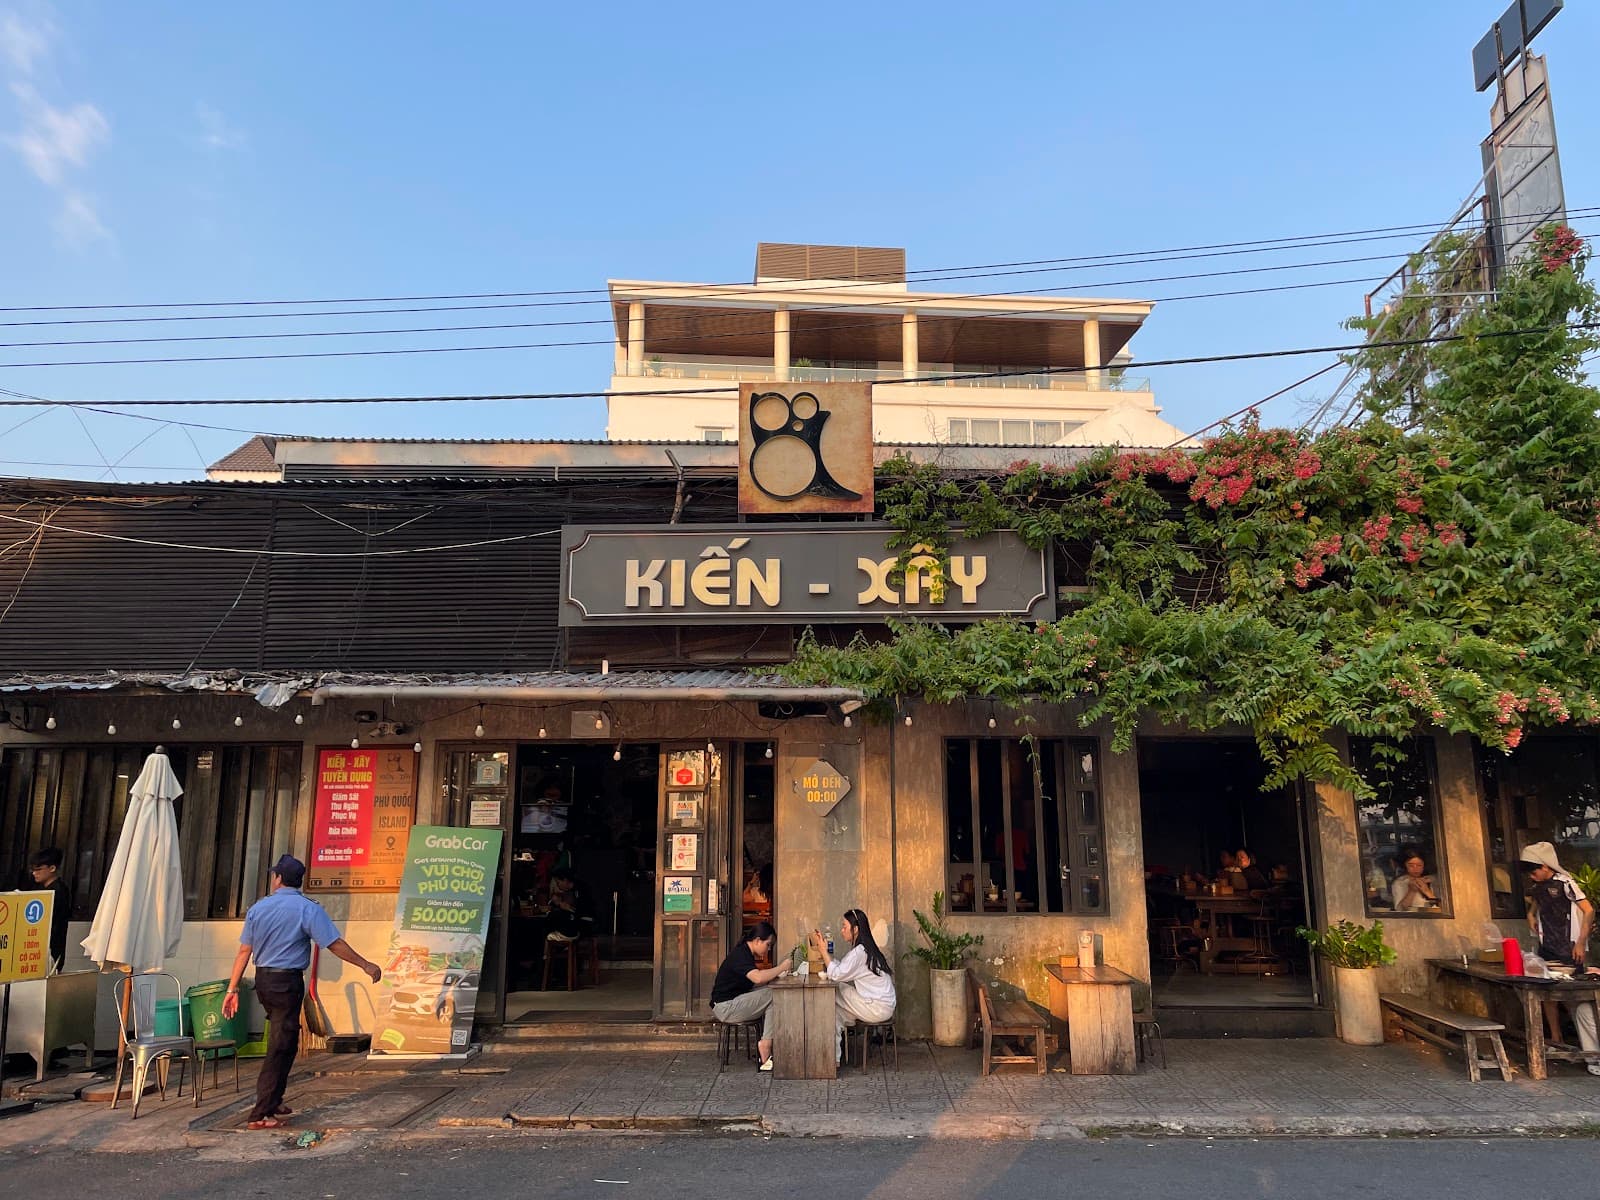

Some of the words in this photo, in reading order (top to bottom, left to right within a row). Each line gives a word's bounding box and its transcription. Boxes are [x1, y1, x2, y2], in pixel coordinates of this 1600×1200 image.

[625, 537, 781, 607] KIẾN
[857, 542, 987, 605] XÂY
[322, 768, 348, 783] TUYỂN
[350, 771, 373, 784] DỤNG
[803, 773, 819, 789] MỞ
[807, 790, 837, 803] 00:00
[379, 815, 407, 828] ISLAND
[425, 834, 489, 851] GrabCar
[414, 857, 429, 865] Get
[422, 864, 449, 878] VUI
[451, 865, 485, 883] CHƠI
[417, 876, 448, 895] PHÚ
[450, 878, 486, 896] QUỐC
[30, 964, 38, 973] XE
